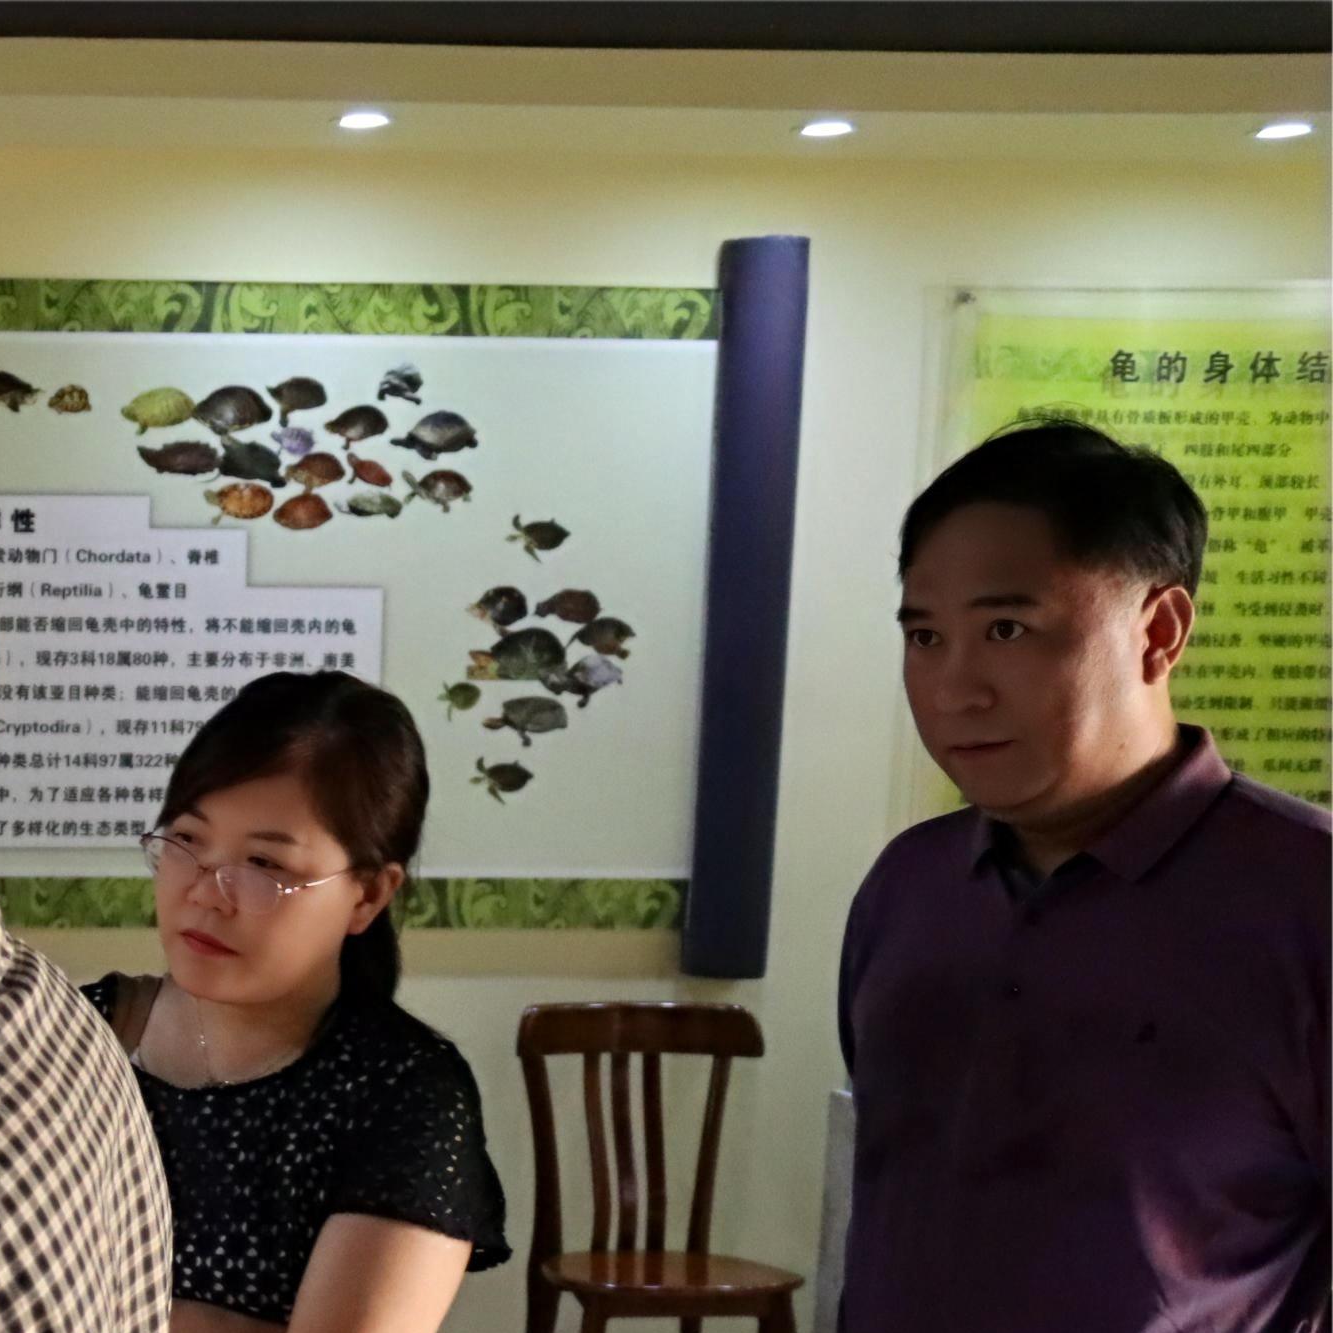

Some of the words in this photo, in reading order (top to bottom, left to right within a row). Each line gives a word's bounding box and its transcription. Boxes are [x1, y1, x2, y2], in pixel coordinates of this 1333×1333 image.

[1110, 349, 1330, 384] 龟的身体结
